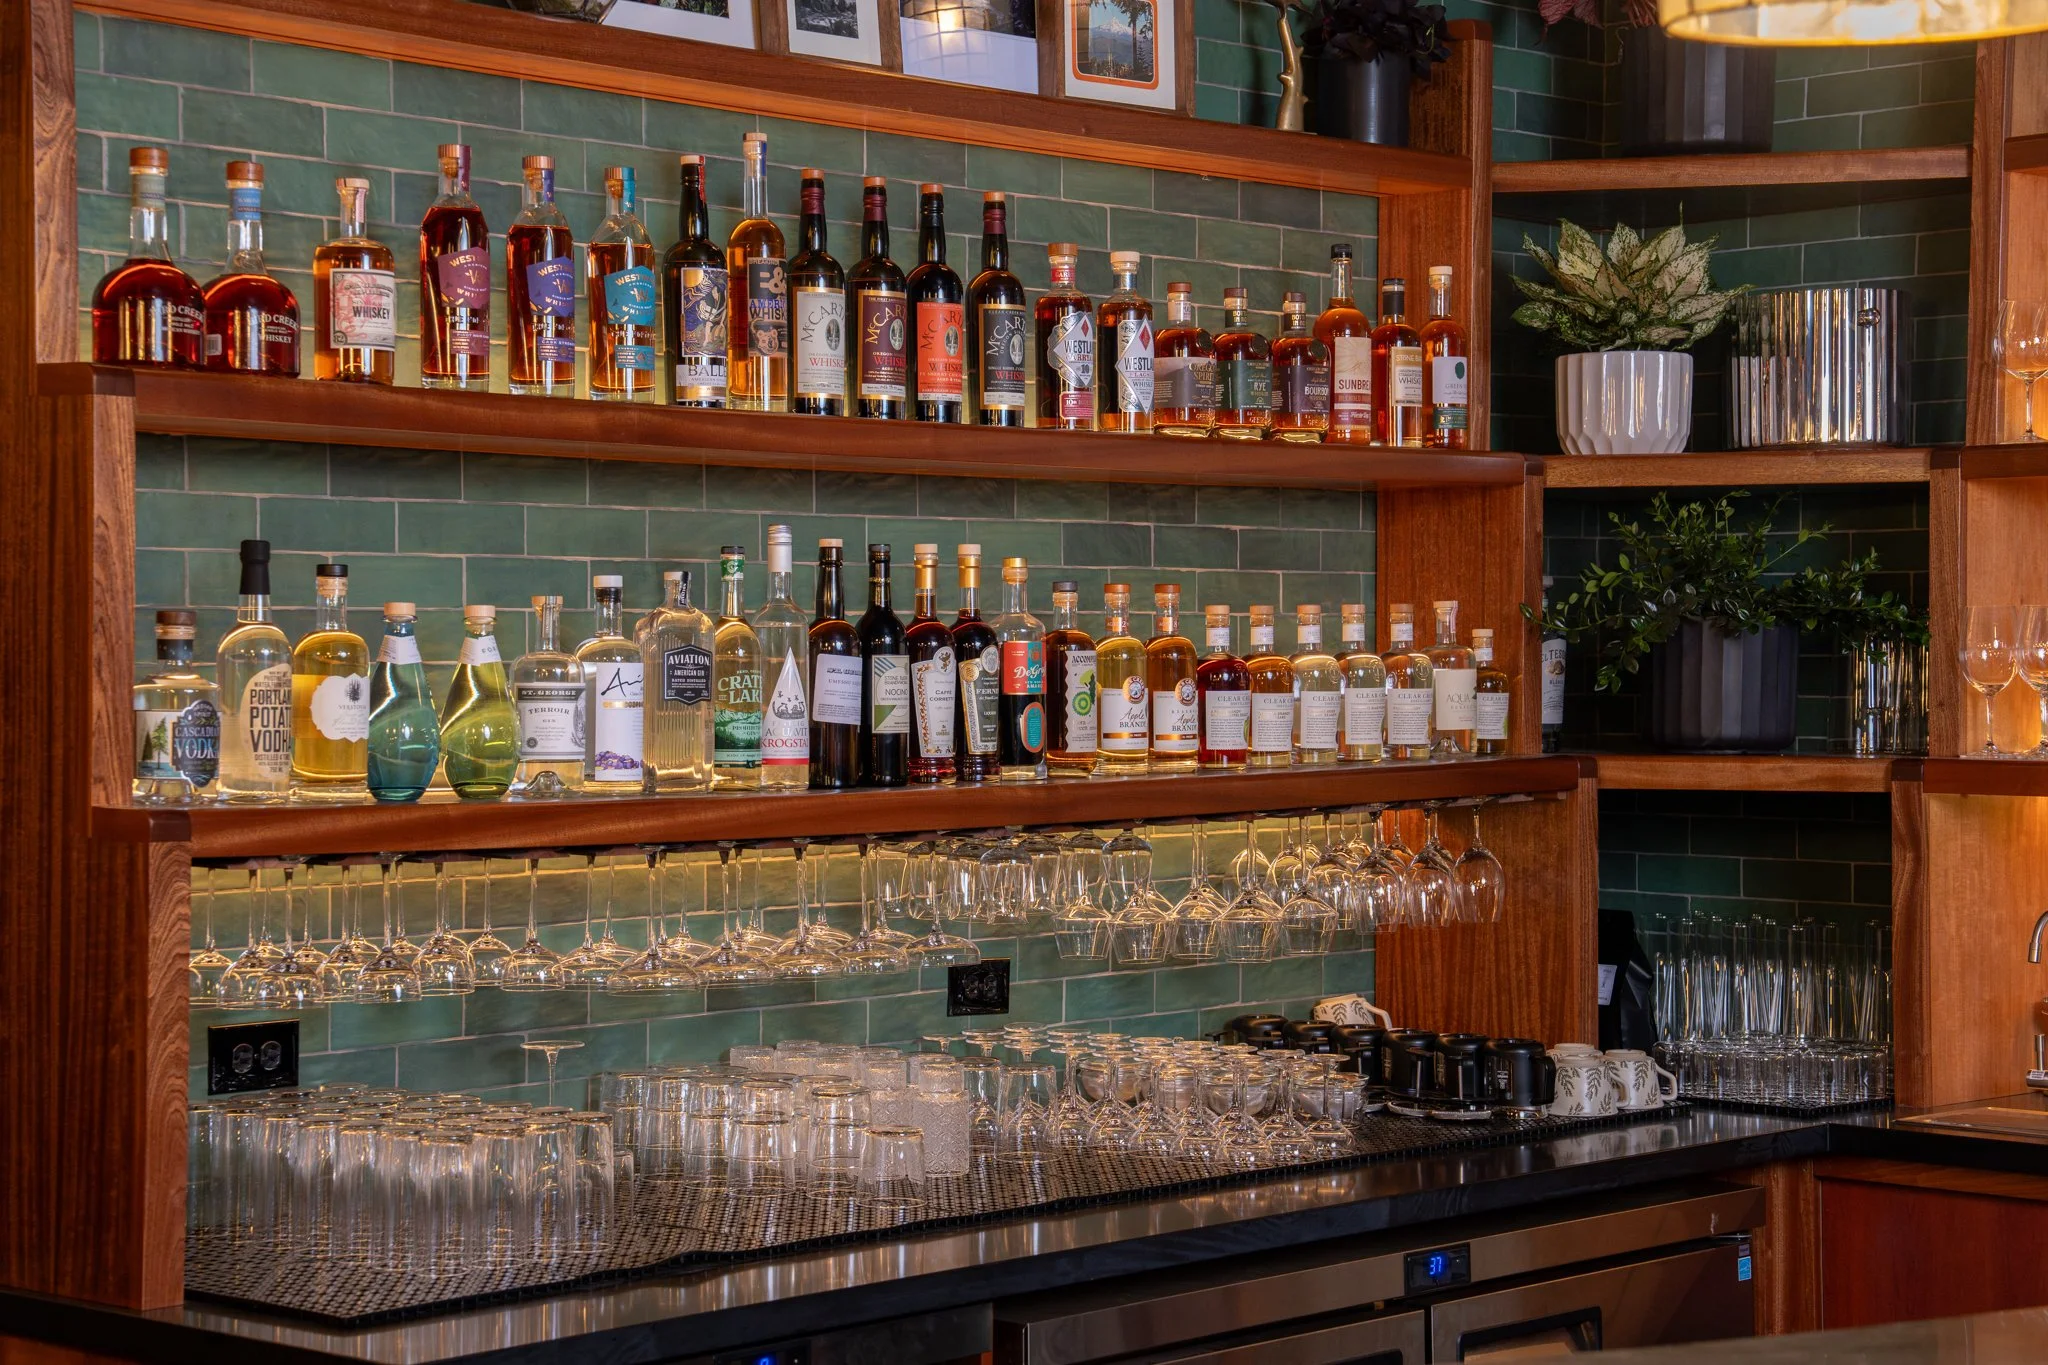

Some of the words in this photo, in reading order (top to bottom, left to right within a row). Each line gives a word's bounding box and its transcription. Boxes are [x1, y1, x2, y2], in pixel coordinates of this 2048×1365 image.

[352, 306, 391, 320] WHISKEY
[1253, 382, 1267, 392] RYE
[668, 654, 711, 666] AVIATION
[528, 707, 570, 715] TERROIR
[1120, 707, 1145, 723] Apple
[1174, 714, 1196, 727] Apple
[1429, 1256, 1442, 1275] 37
